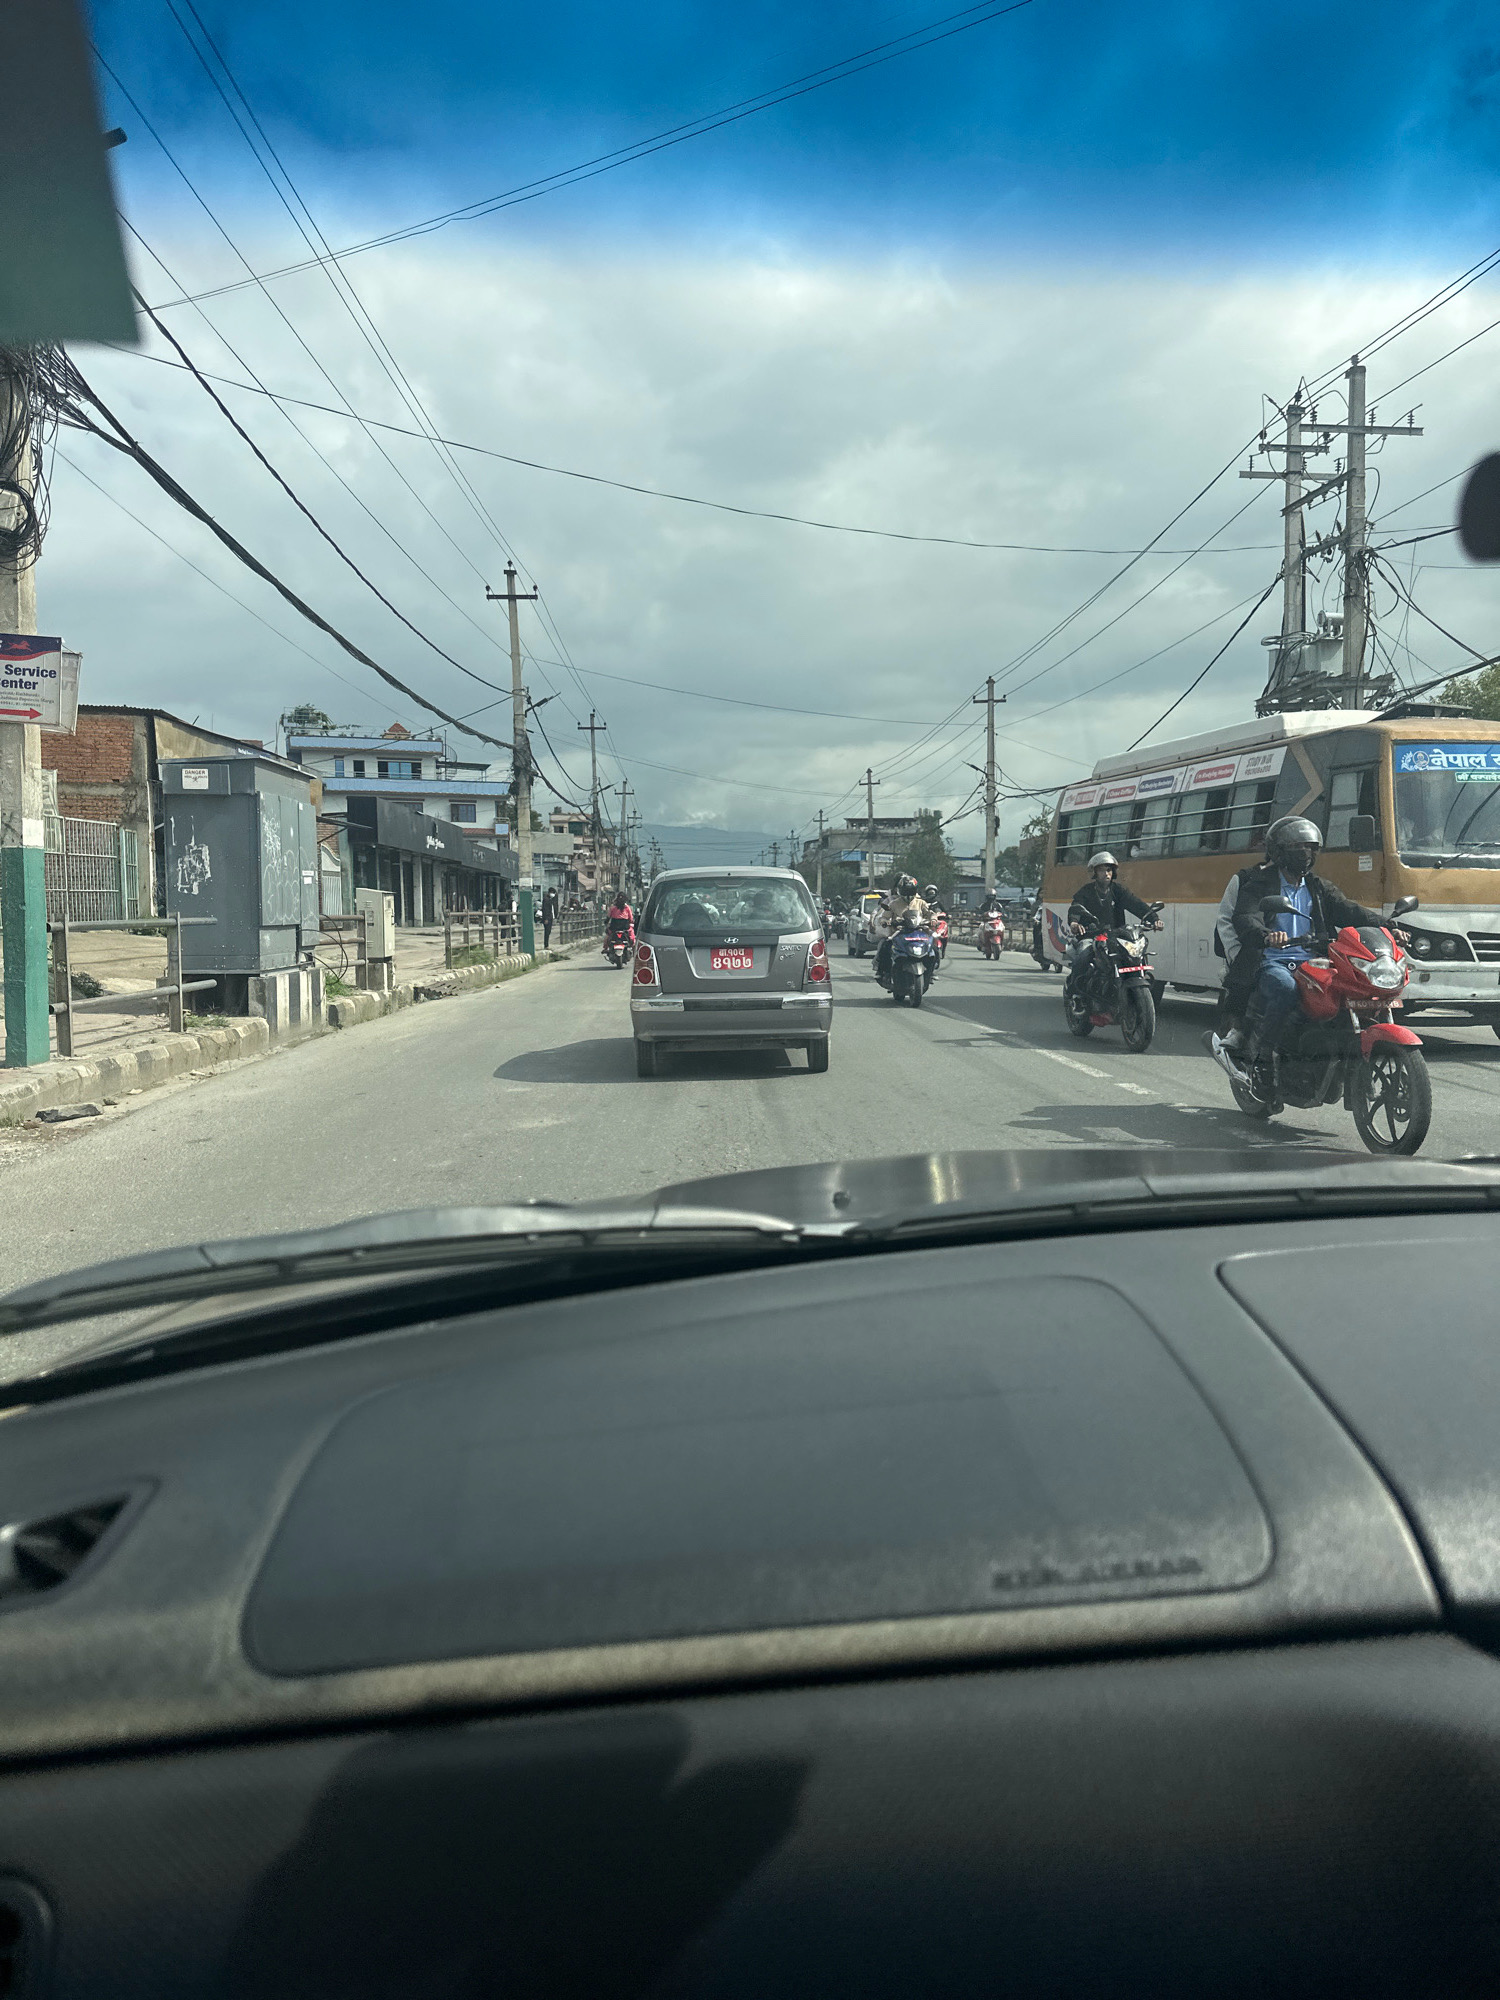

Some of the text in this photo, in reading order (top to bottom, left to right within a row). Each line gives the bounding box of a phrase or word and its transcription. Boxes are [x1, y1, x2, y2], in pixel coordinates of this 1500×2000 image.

[4, 664, 57, 678] Service
[0, 678, 38, 690] enter
[1429, 748, 1487, 768] नेपाल
[713, 956, 752, 969] ४१७७
